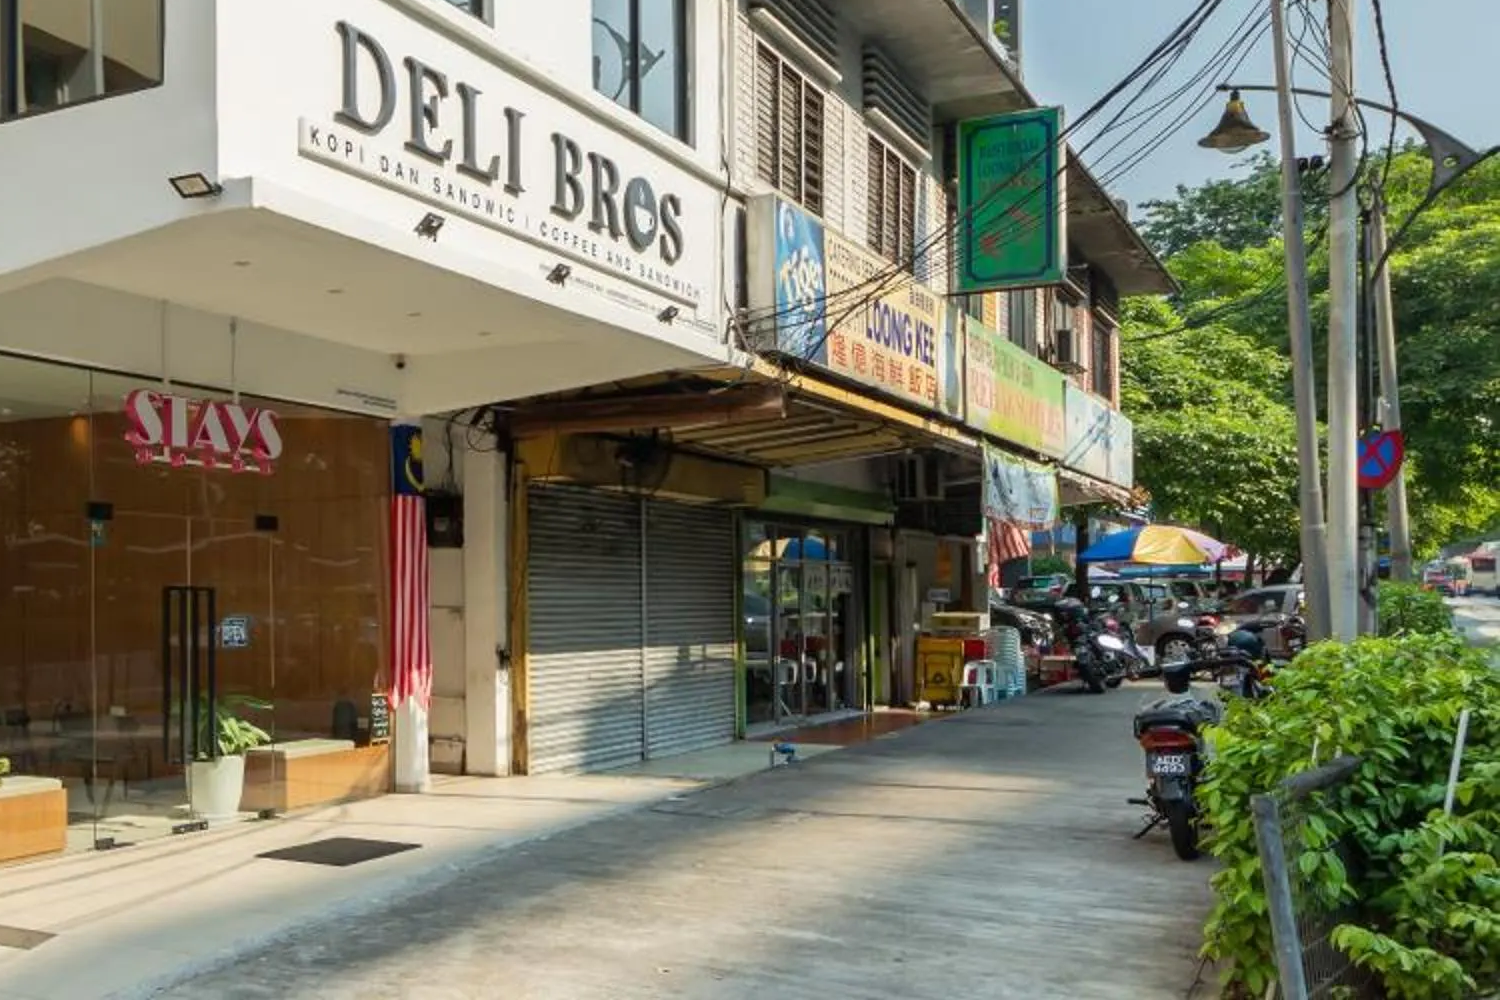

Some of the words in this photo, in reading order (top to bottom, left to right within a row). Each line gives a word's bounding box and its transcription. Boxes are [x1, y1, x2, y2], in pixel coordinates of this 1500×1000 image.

[333, 20, 527, 198] DELI
[549, 131, 685, 267] BROS
[310, 125, 364, 164] KOPI
[379, 155, 420, 186] DAN
[432, 176, 516, 224] SANDWIC
[539, 221, 598, 258] COFFEE
[606, 250, 632, 272] AND
[639, 263, 700, 299] SANDWICH
[866, 299, 913, 357] LOONG
[915, 321, 936, 368] KEE
[124, 388, 284, 475] STAYS
